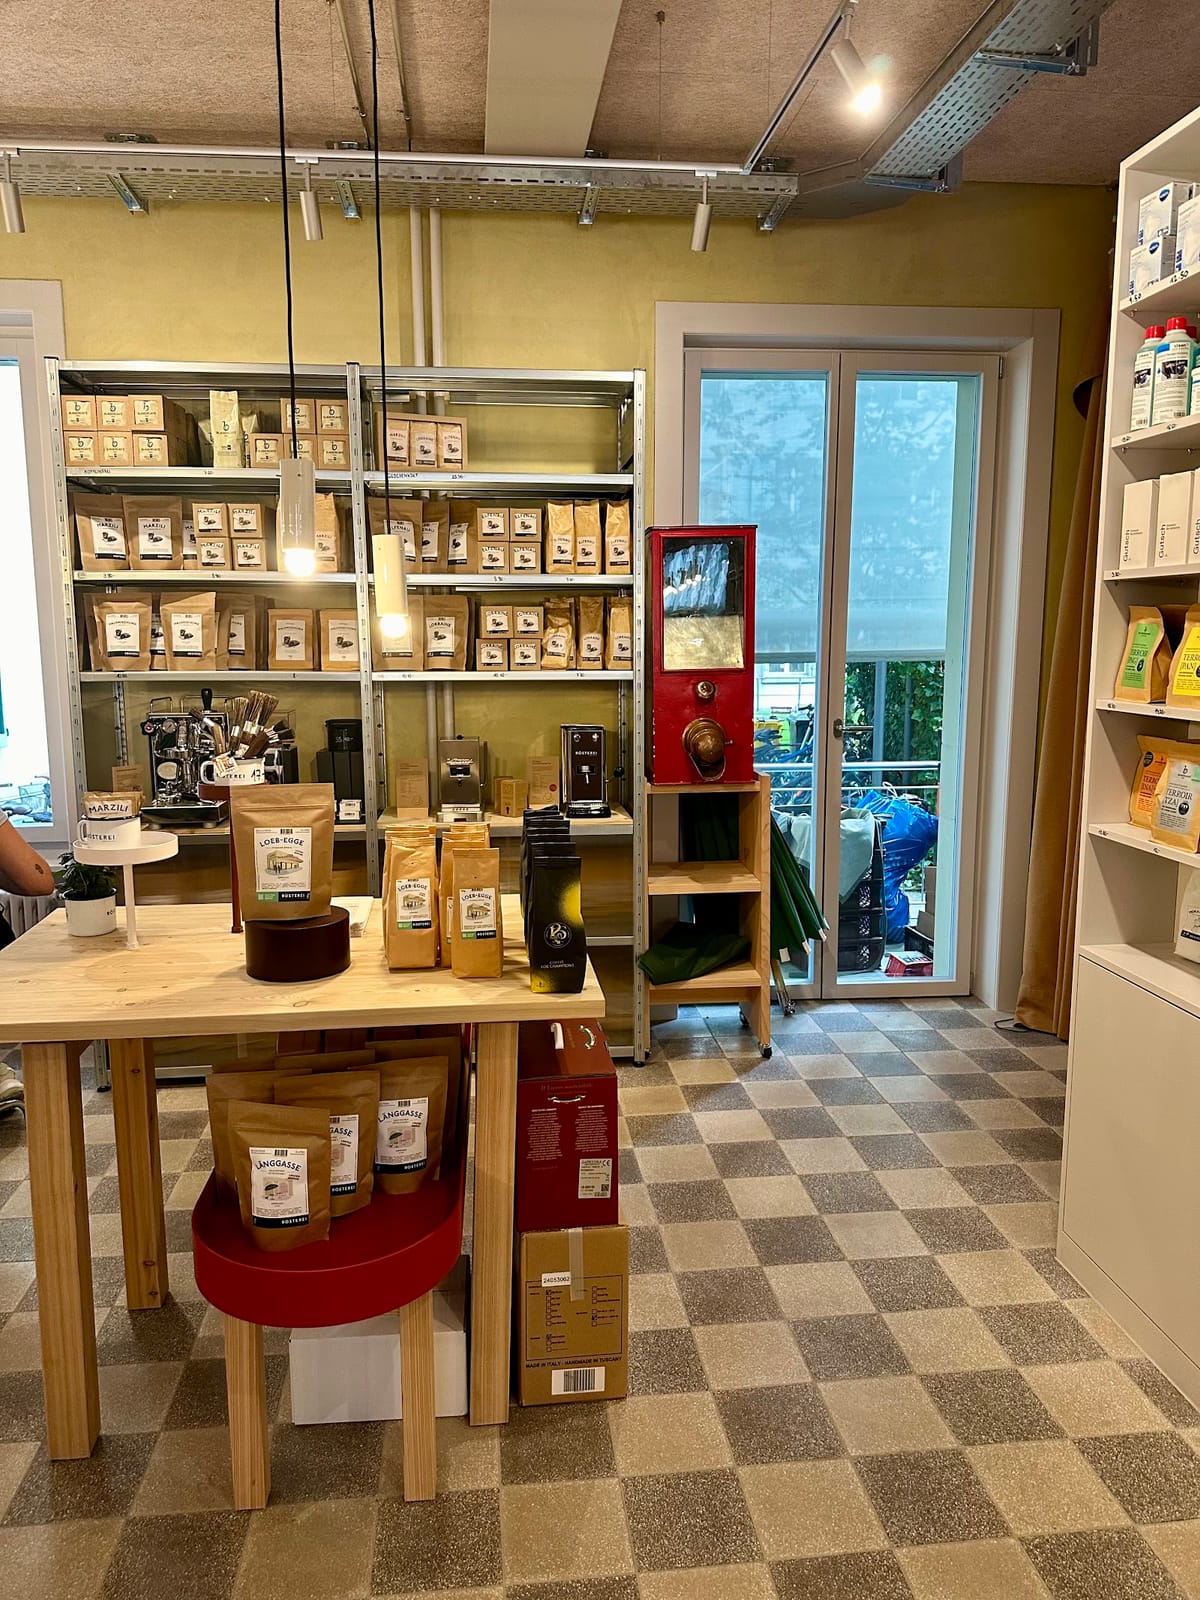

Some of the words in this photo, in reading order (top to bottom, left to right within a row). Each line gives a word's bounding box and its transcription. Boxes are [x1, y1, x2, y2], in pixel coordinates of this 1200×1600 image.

[1122, 529, 1130, 562] Gutsch
[1158, 523, 1166, 558] Gutsch
[428, 621, 452, 629] LORRAINE
[88, 804, 129, 814] MARZILI
[259, 837, 305, 848] LOEB-EGGE
[461, 892, 493, 901] LOEB-EGGE
[378, 1109, 423, 1123] LÄNGGASSE
[329, 1126, 353, 1138] GASSE
[255, 1159, 302, 1172] LÄNGGASSE
[281, 1216, 308, 1225] RÖSTEREI
